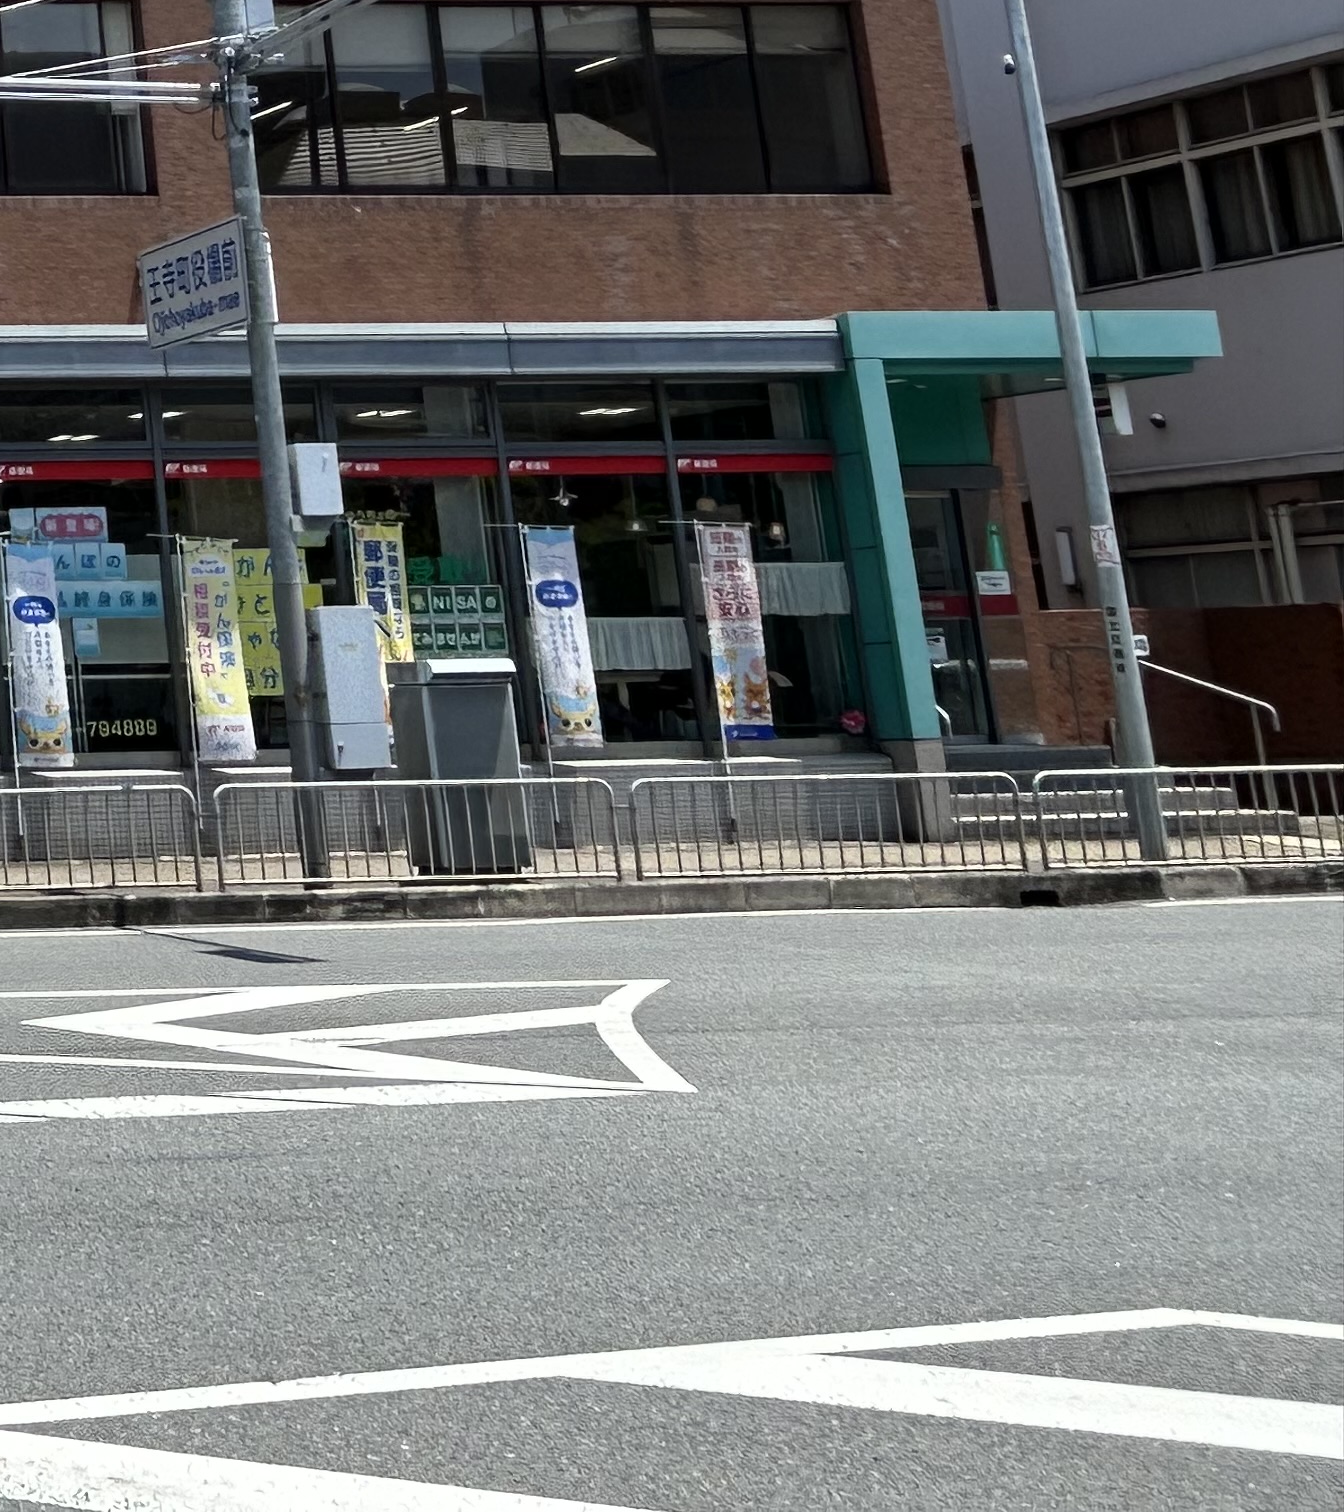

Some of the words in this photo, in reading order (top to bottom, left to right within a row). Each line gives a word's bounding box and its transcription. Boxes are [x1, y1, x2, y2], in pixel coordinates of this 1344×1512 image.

[147, 237, 239, 306] 王寺町役場前
[433, 595, 478, 610] NISA
